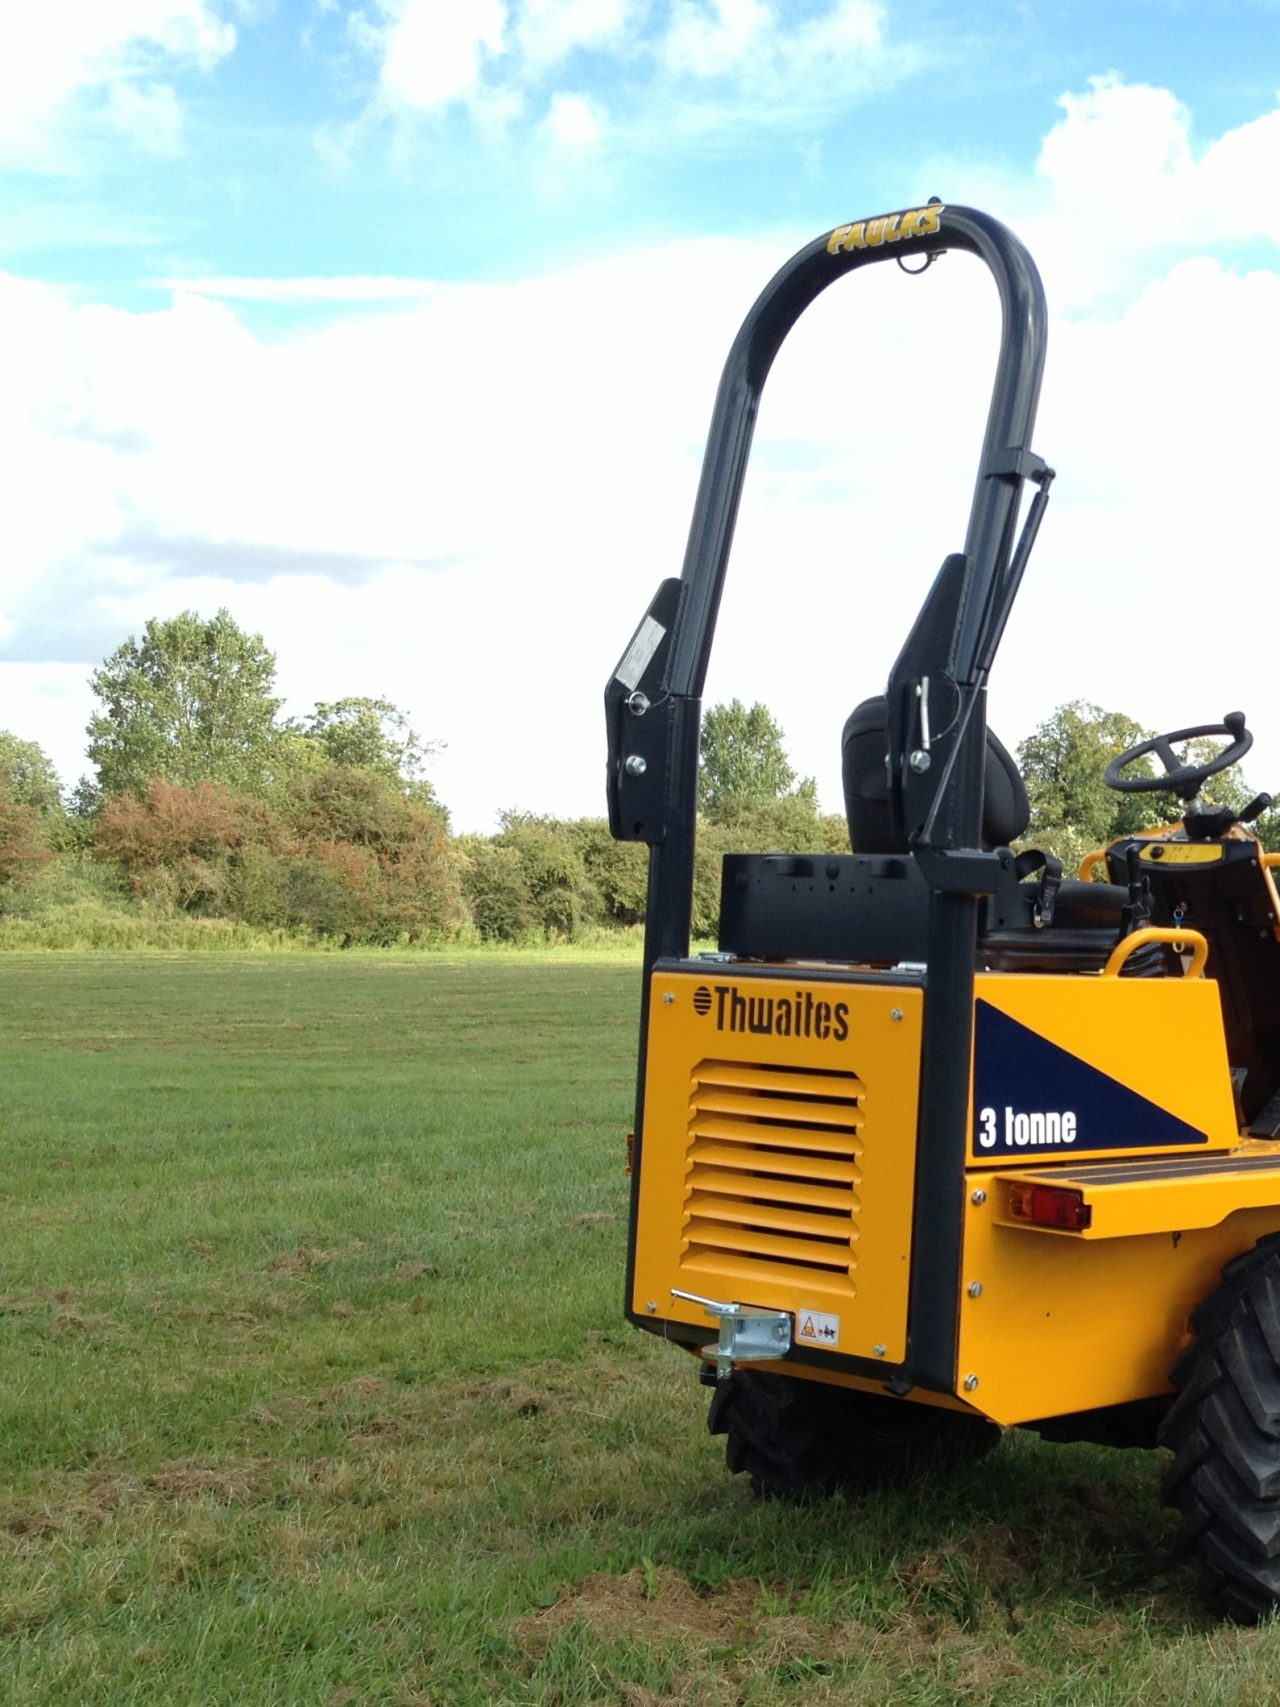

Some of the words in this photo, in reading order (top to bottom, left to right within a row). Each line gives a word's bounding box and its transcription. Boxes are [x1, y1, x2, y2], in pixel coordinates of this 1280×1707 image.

[827, 206, 945, 254] FAULKS
[714, 986, 849, 1041] Thwaites
[980, 1107, 996, 1148] 3
[1005, 1106, 1077, 1146] tonne
